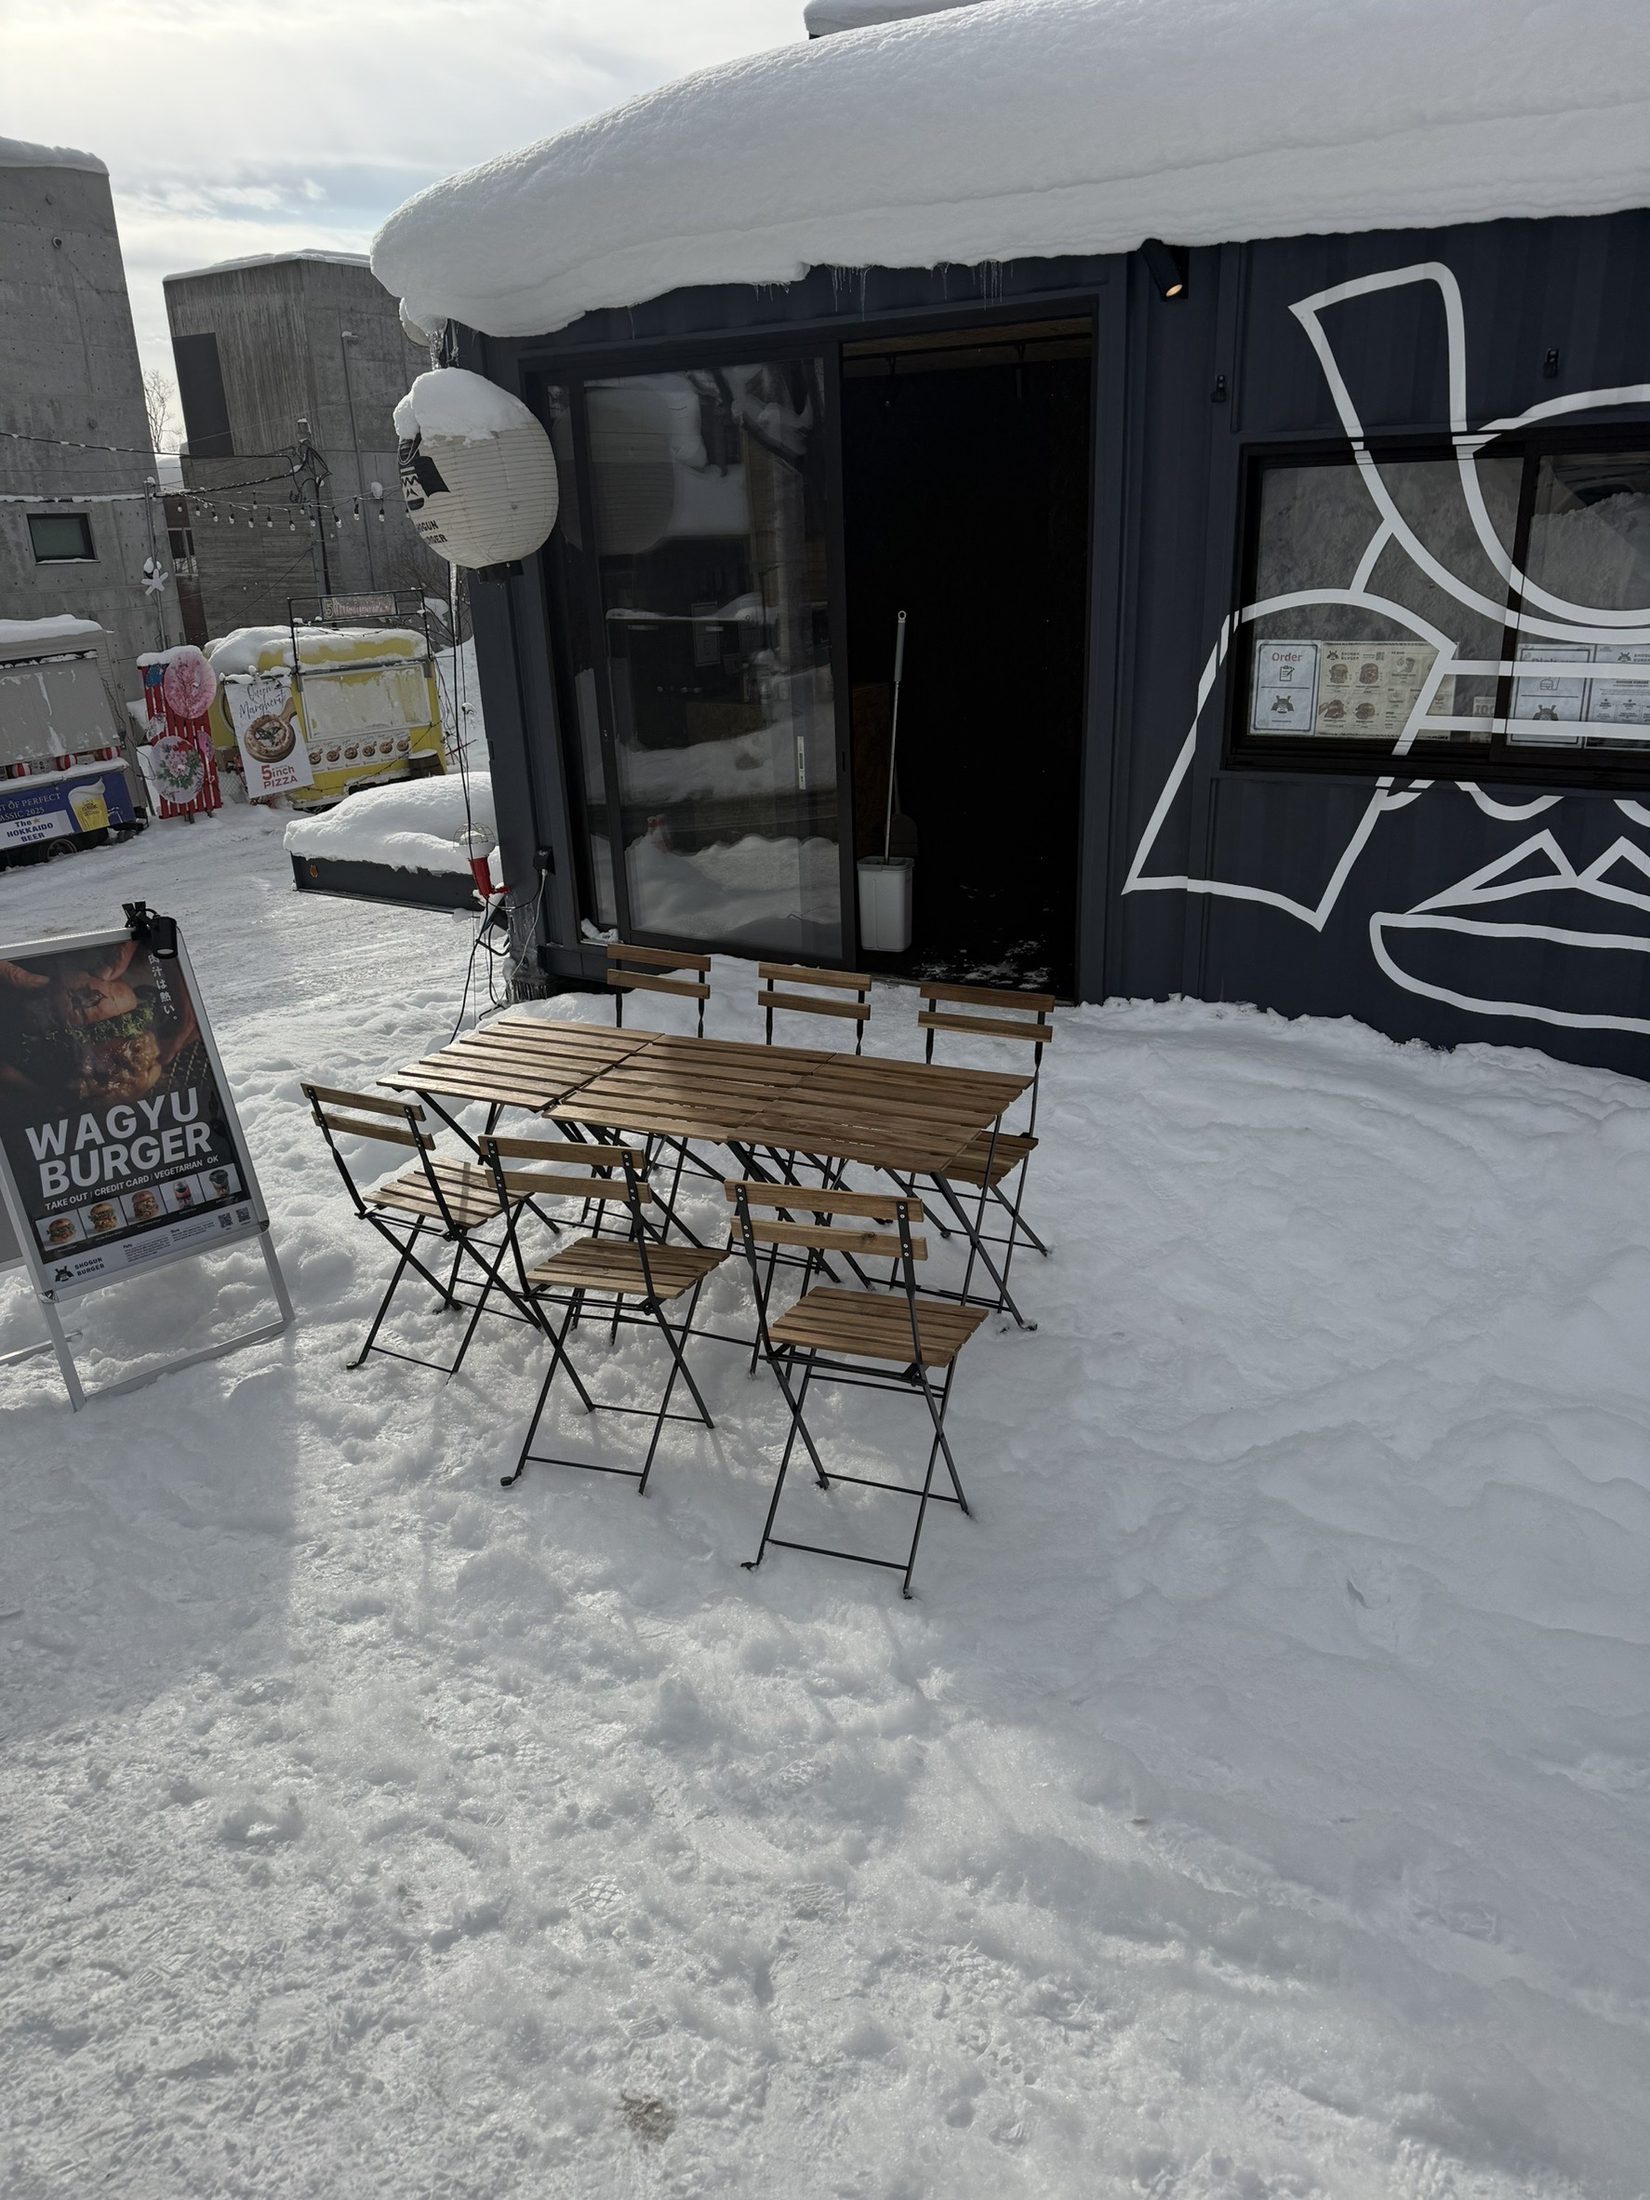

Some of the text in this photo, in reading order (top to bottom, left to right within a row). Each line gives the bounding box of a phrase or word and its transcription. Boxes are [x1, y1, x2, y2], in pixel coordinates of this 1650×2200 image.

[1271, 652, 1304, 662] Order
[263, 775, 298, 789] PIZZA
[21, 793, 61, 807] PERFECT
[26, 807, 45, 816] 2025
[6, 822, 54, 838] HOKKAIDO
[15, 820, 33, 828] The
[20, 832, 46, 842] BEER
[25, 1087, 200, 1161] WAGYU
[39, 1122, 213, 1199] BURGER
[45, 1197, 69, 1211] TAKE
[69, 1192, 88, 1206] OUT
[94, 1183, 125, 1197] CREDIT
[125, 1175, 150, 1188] CARD
[154, 1160, 203, 1180] VEGETARIAN
[206, 1155, 219, 1165] OK
[75, 1257, 103, 1270] SHOGUN
[77, 1263, 105, 1276] BURGER
